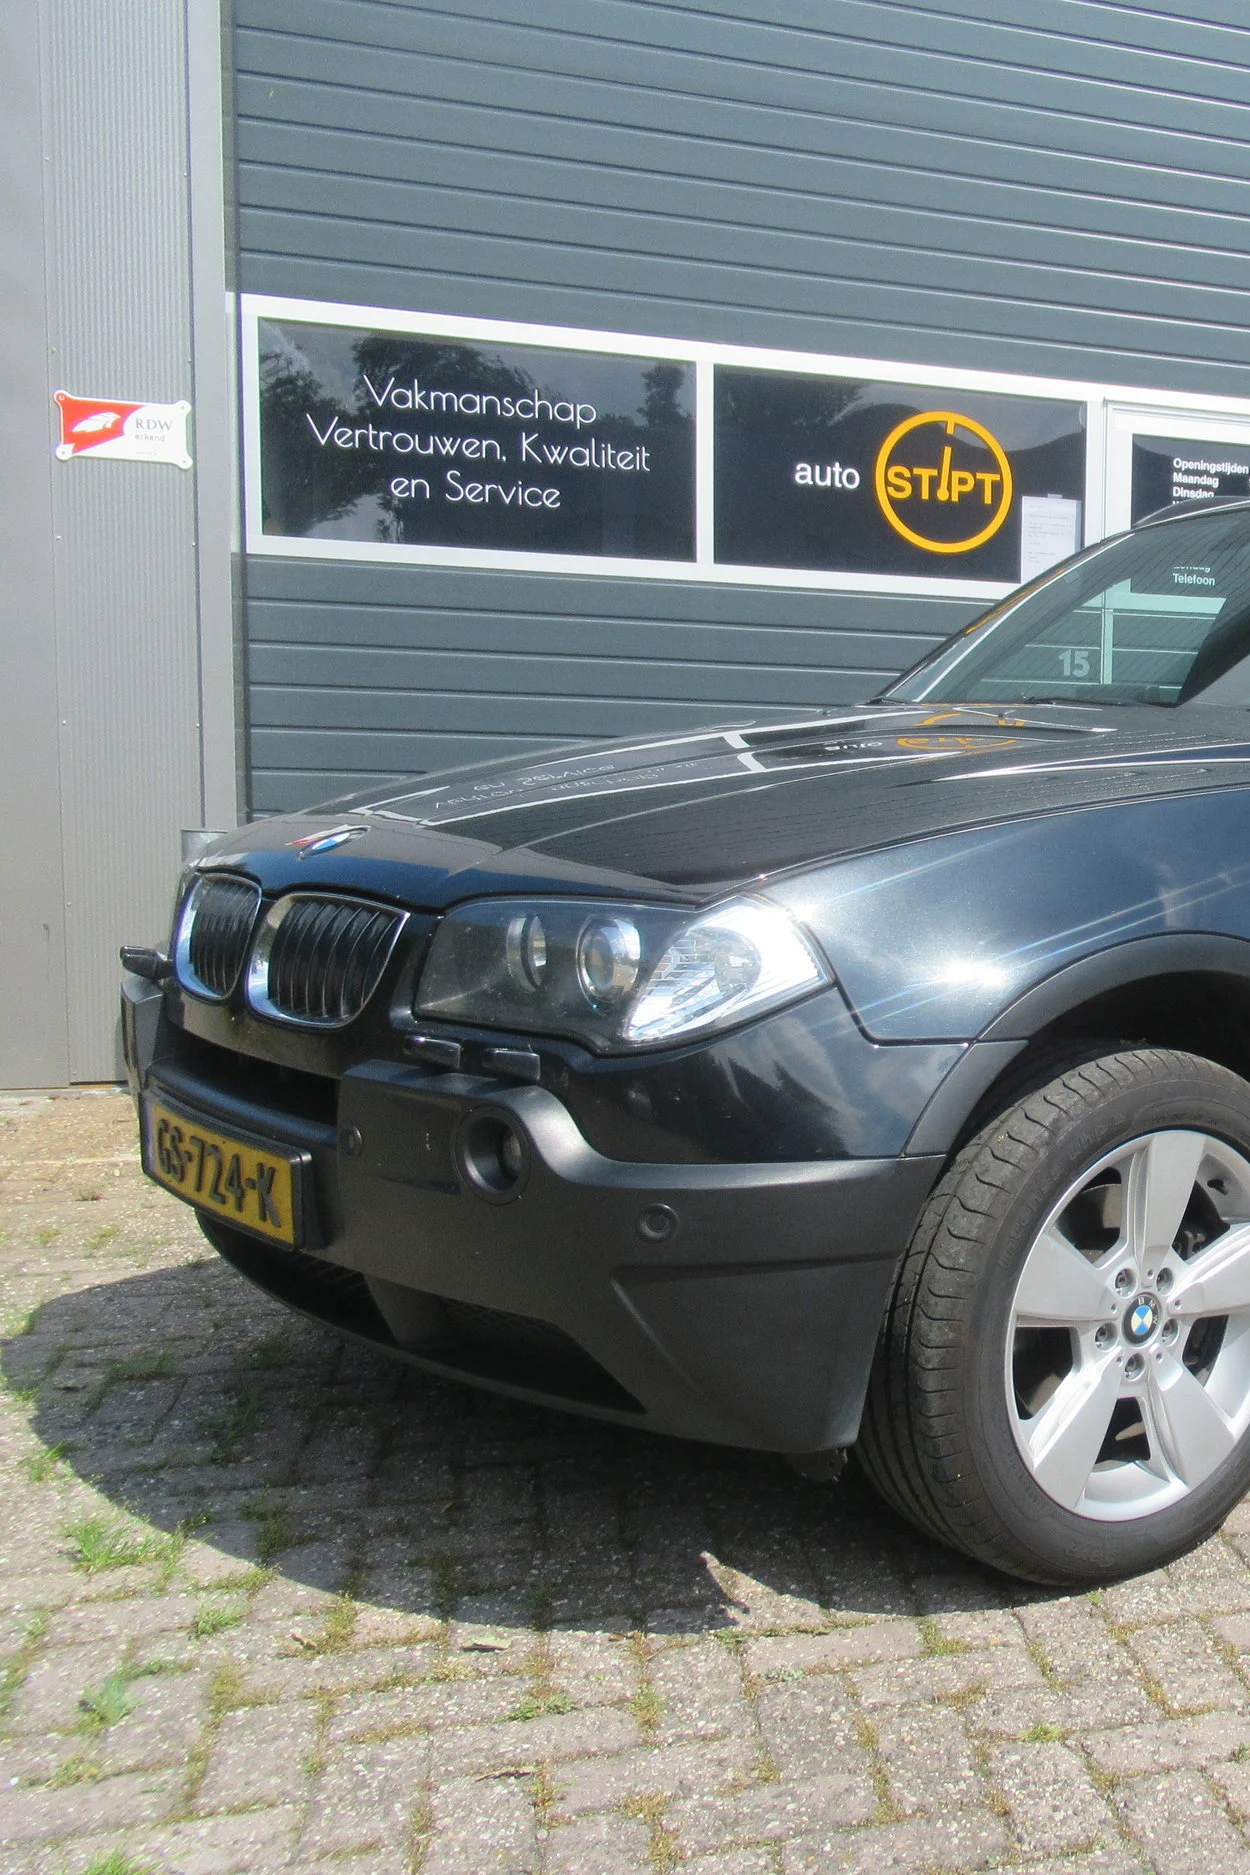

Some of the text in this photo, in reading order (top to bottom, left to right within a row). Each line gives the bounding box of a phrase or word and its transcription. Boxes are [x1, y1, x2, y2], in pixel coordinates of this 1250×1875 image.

[363, 374, 597, 429] Vakmanschap
[135, 418, 174, 431] RDW
[135, 433, 166, 442] erkend
[306, 413, 651, 472] Vertrouwen, Kwaliteit
[794, 462, 861, 489] auto
[1173, 458, 1249, 475] Openingstijden
[390, 470, 561, 508] en Service
[1173, 472, 1219, 488] Maandag
[1172, 573, 1216, 586] Telefoon
[1058, 649, 1090, 677] 15
